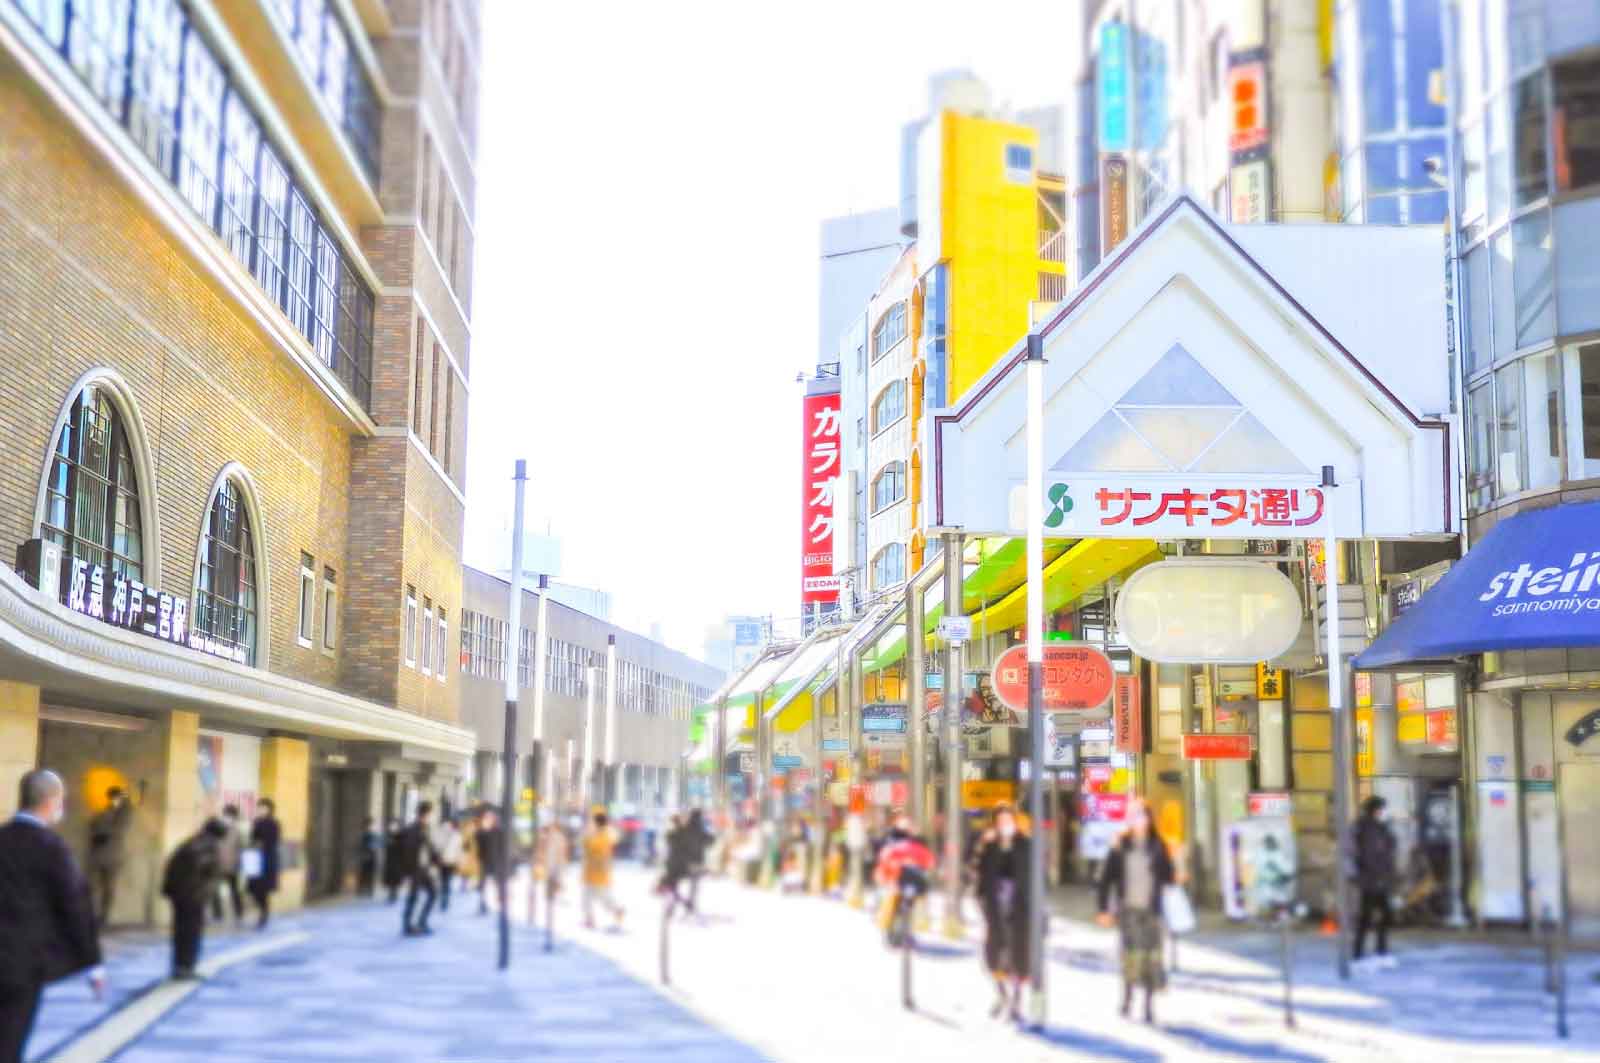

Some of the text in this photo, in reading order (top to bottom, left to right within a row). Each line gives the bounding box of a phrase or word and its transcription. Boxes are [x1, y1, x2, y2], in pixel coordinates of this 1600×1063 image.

[1095, 488, 1324, 526] サンキタ通り
[1492, 593, 1600, 617] sannomiya
